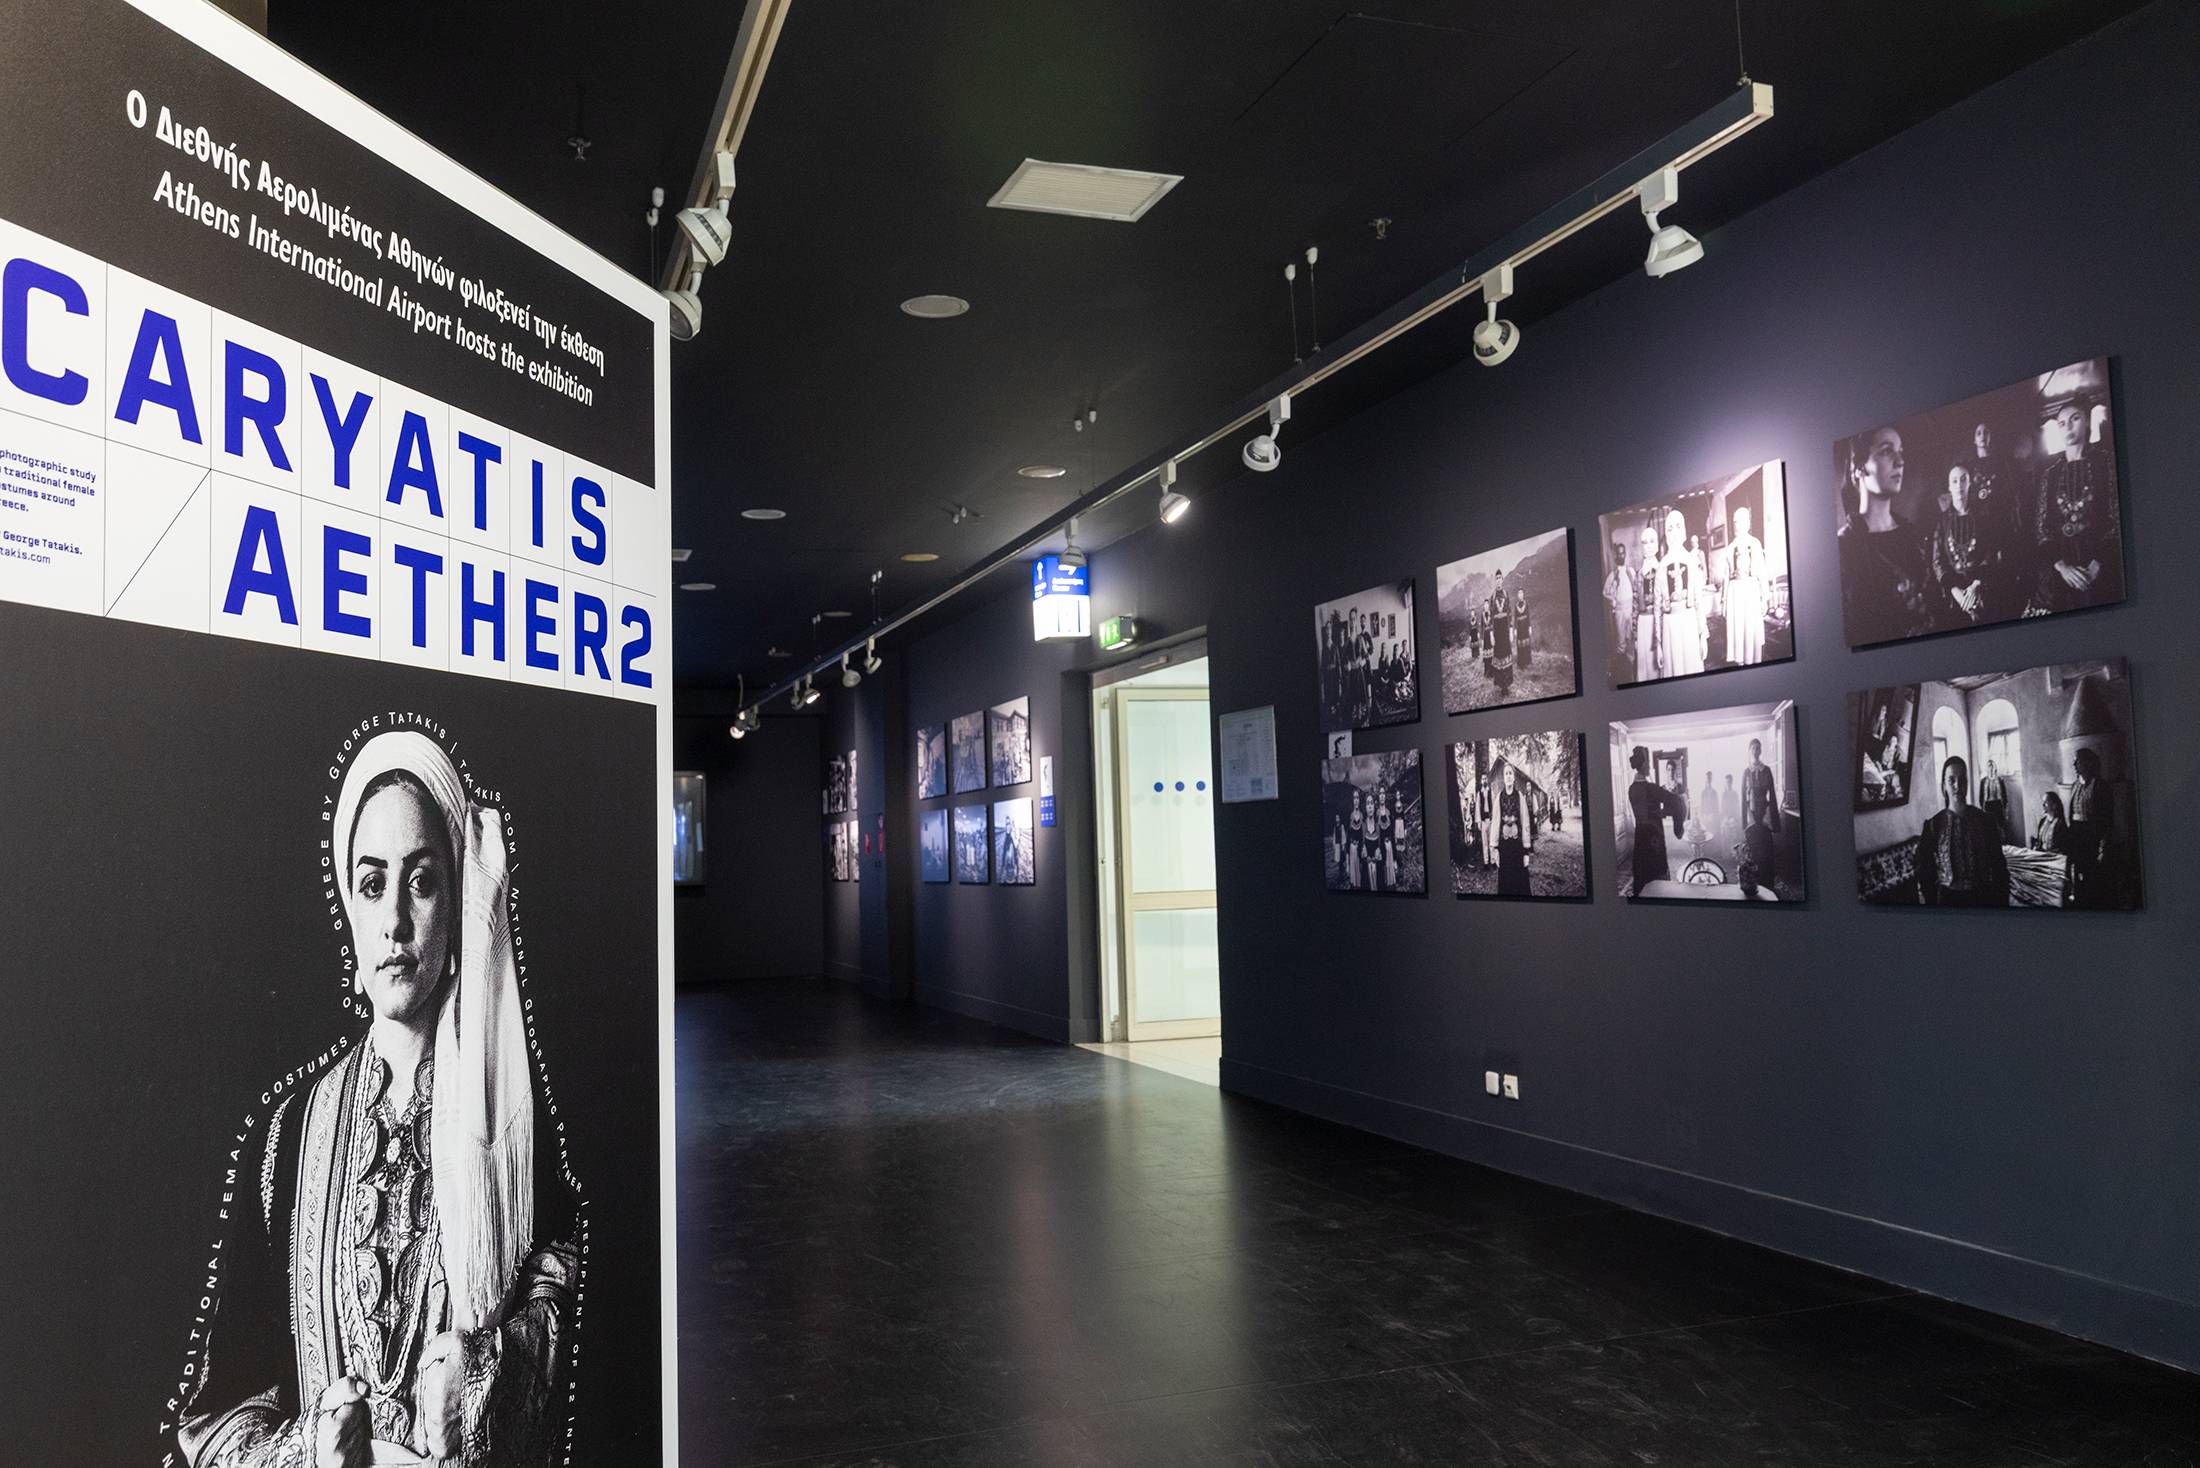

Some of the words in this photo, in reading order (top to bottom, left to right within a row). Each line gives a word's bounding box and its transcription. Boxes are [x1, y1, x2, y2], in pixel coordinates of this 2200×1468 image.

[126, 89, 147, 128] Ο
[155, 105, 251, 191] Διεθνής
[256, 160, 383, 260] Αερολιμένας
[387, 231, 455, 291] Αθηνών
[459, 276, 531, 331] φιλοξενεί
[533, 315, 557, 349] την
[560, 323, 605, 377] έκθεση
[153, 170, 240, 239] Athens
[248, 213, 383, 307] International
[387, 285, 452, 334] Airport
[456, 317, 497, 361] hosts
[501, 342, 525, 375] the
[528, 360, 593, 407] exhibition
[2, 258, 606, 566] CARYATIS
[0, 481, 39, 499] stumes
[41, 493, 75, 507] around
[4, 466, 61, 488] traditional
[63, 480, 95, 496] female
[70, 468, 96, 484] study
[3, 530, 40, 548] George
[42, 538, 83, 555] Tatakis.
[222, 505, 652, 689] AETHER2
[329, 715, 380, 780] GEORGE
[388, 711, 446, 739] TATAKIS
[322, 795, 333, 821] BY
[460, 759, 516, 854] TATAKIS.COM
[321, 839, 343, 931] GREECE
[340, 945, 369, 1019] AROUND
[510, 887, 529, 988] NATIONAL
[261, 1036, 348, 1105] COSTUMES
[524, 998, 557, 1116] GEOGRAPHIC
[219, 1114, 255, 1221] FEMALE
[556, 1122, 583, 1193] PARTNER
[575, 1219, 590, 1330] RECIPIENT
[159, 1239, 223, 1435] TRADITIONAL
